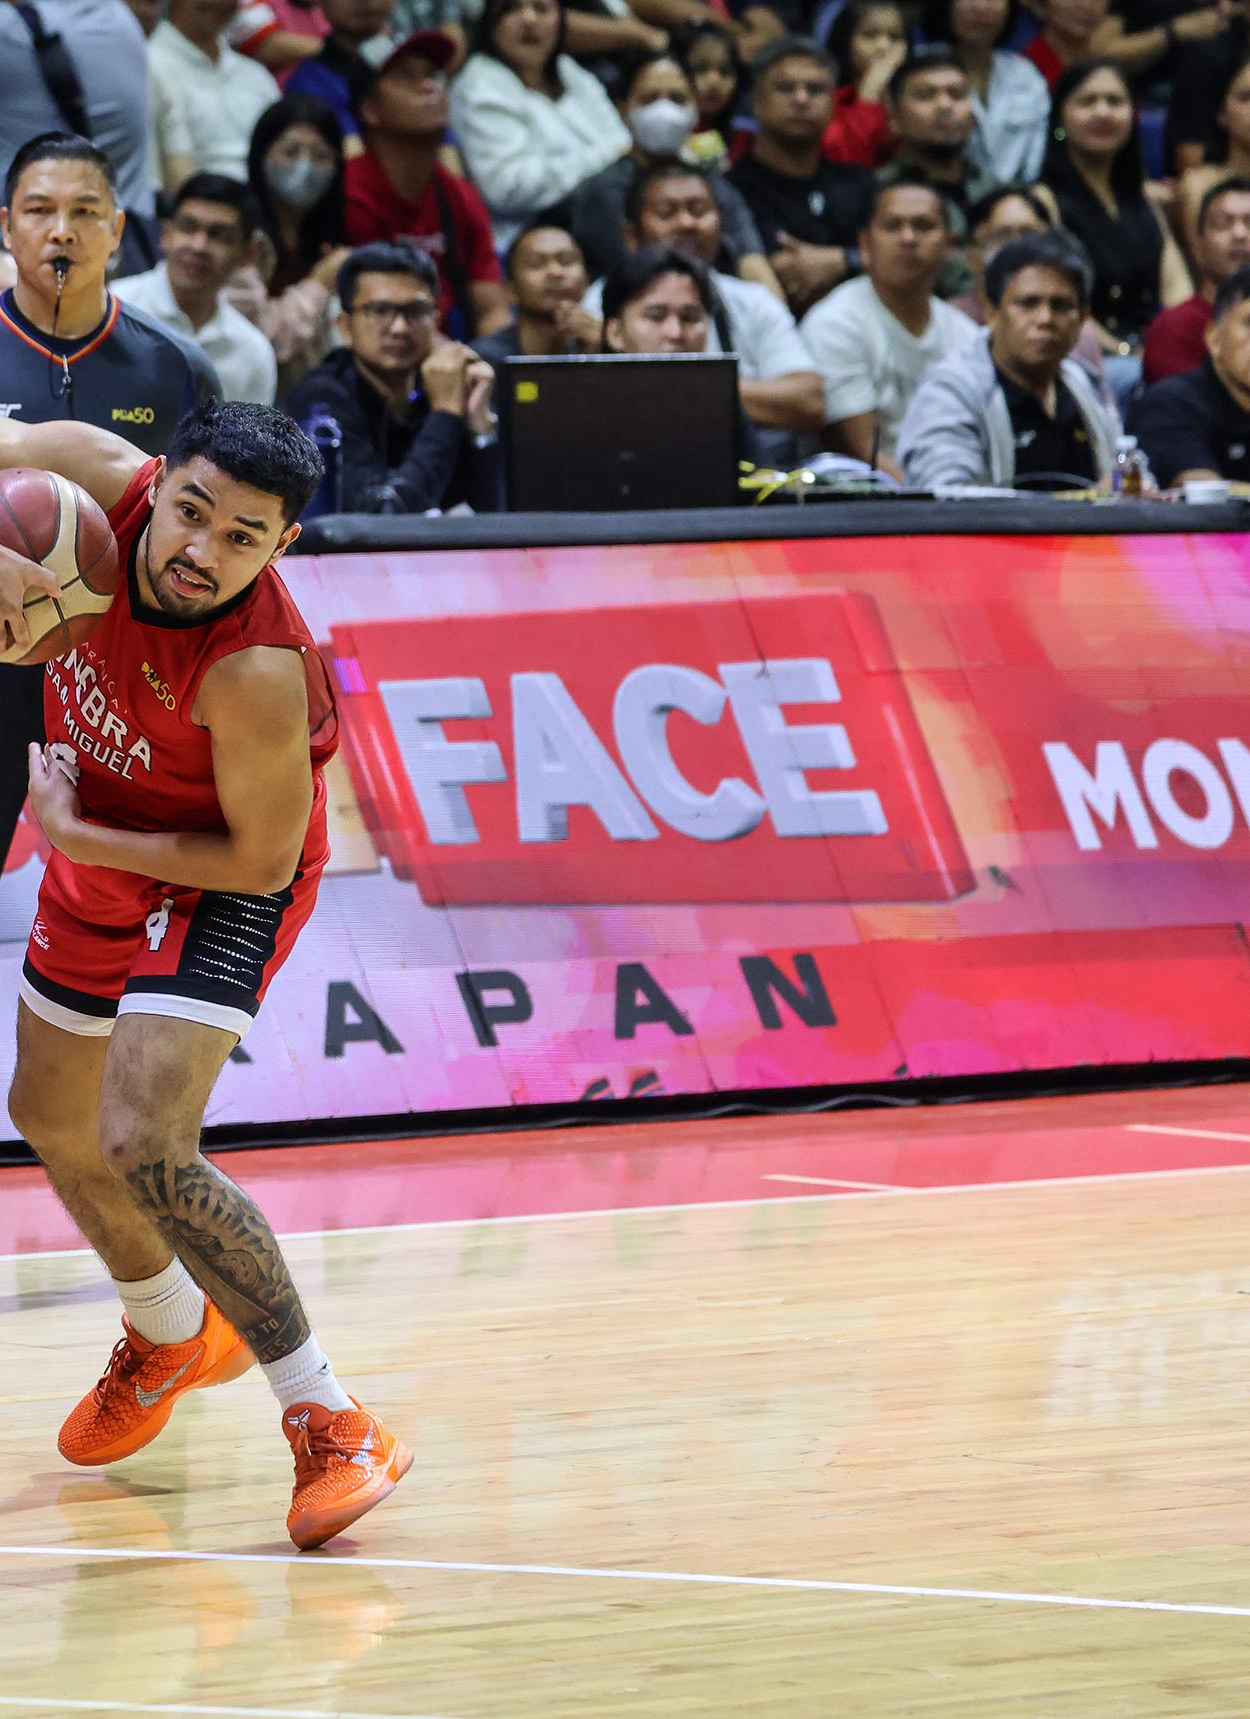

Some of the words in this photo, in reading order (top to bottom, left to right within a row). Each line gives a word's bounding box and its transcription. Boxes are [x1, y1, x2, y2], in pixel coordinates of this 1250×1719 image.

[63, 707, 134, 781] MIGUEL
[377, 657, 890, 845] FACE
[234, 952, 838, 1066] APAN
